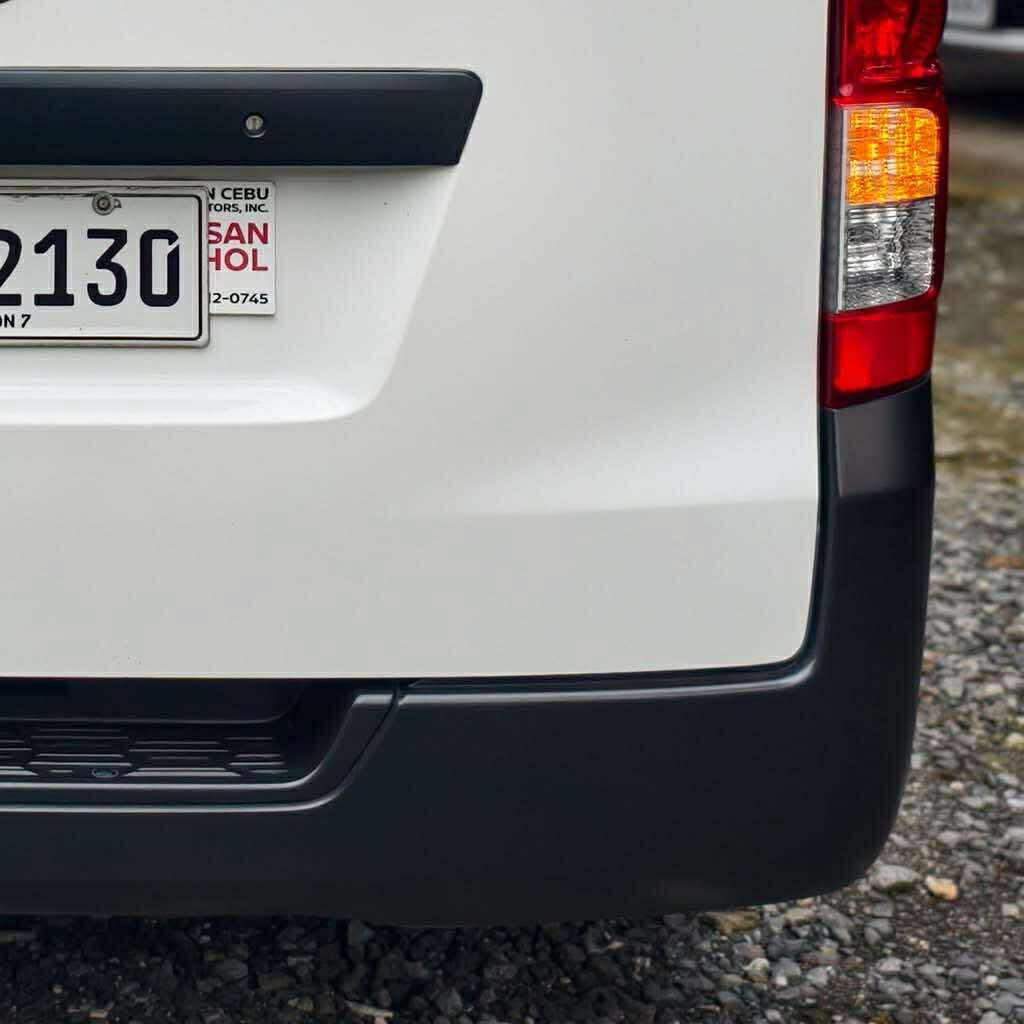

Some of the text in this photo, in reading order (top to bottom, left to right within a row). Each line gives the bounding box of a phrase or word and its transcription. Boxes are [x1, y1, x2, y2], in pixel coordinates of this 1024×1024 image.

[221, 187, 269, 200] CEBU
[245, 203, 269, 213] INC.
[21, 313, 32, 329] 7
